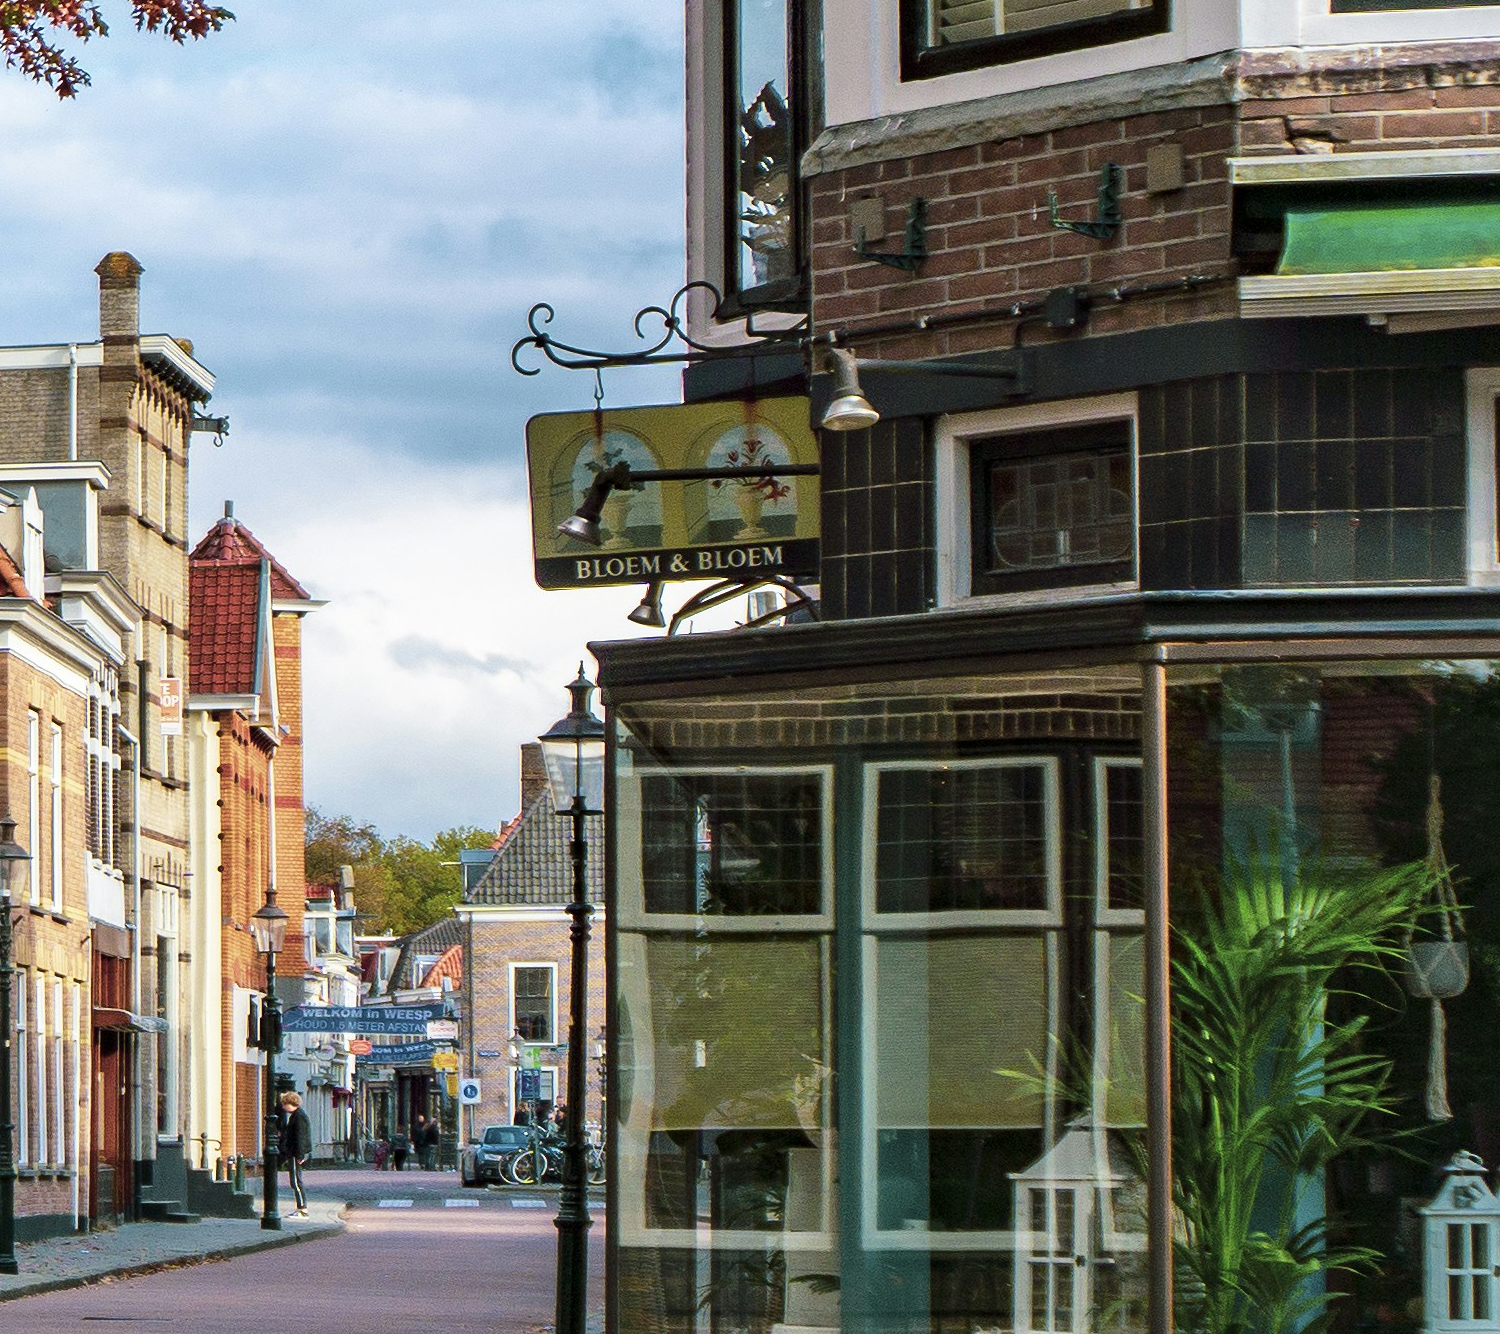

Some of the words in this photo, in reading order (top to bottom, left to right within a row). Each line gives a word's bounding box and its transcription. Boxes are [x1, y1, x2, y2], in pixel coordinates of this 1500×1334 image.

[576, 555, 661, 579] BLOEM
[670, 553, 689, 573] &
[698, 546, 783, 570] BLOEM
[302, 1008, 363, 1018] WELKOM
[367, 1009, 380, 1019] in
[385, 1009, 433, 1020] WEESP
[295, 1019, 328, 1029] HOUD
[348, 1021, 385, 1032] METER
[387, 1022, 428, 1033] AFSTAN
